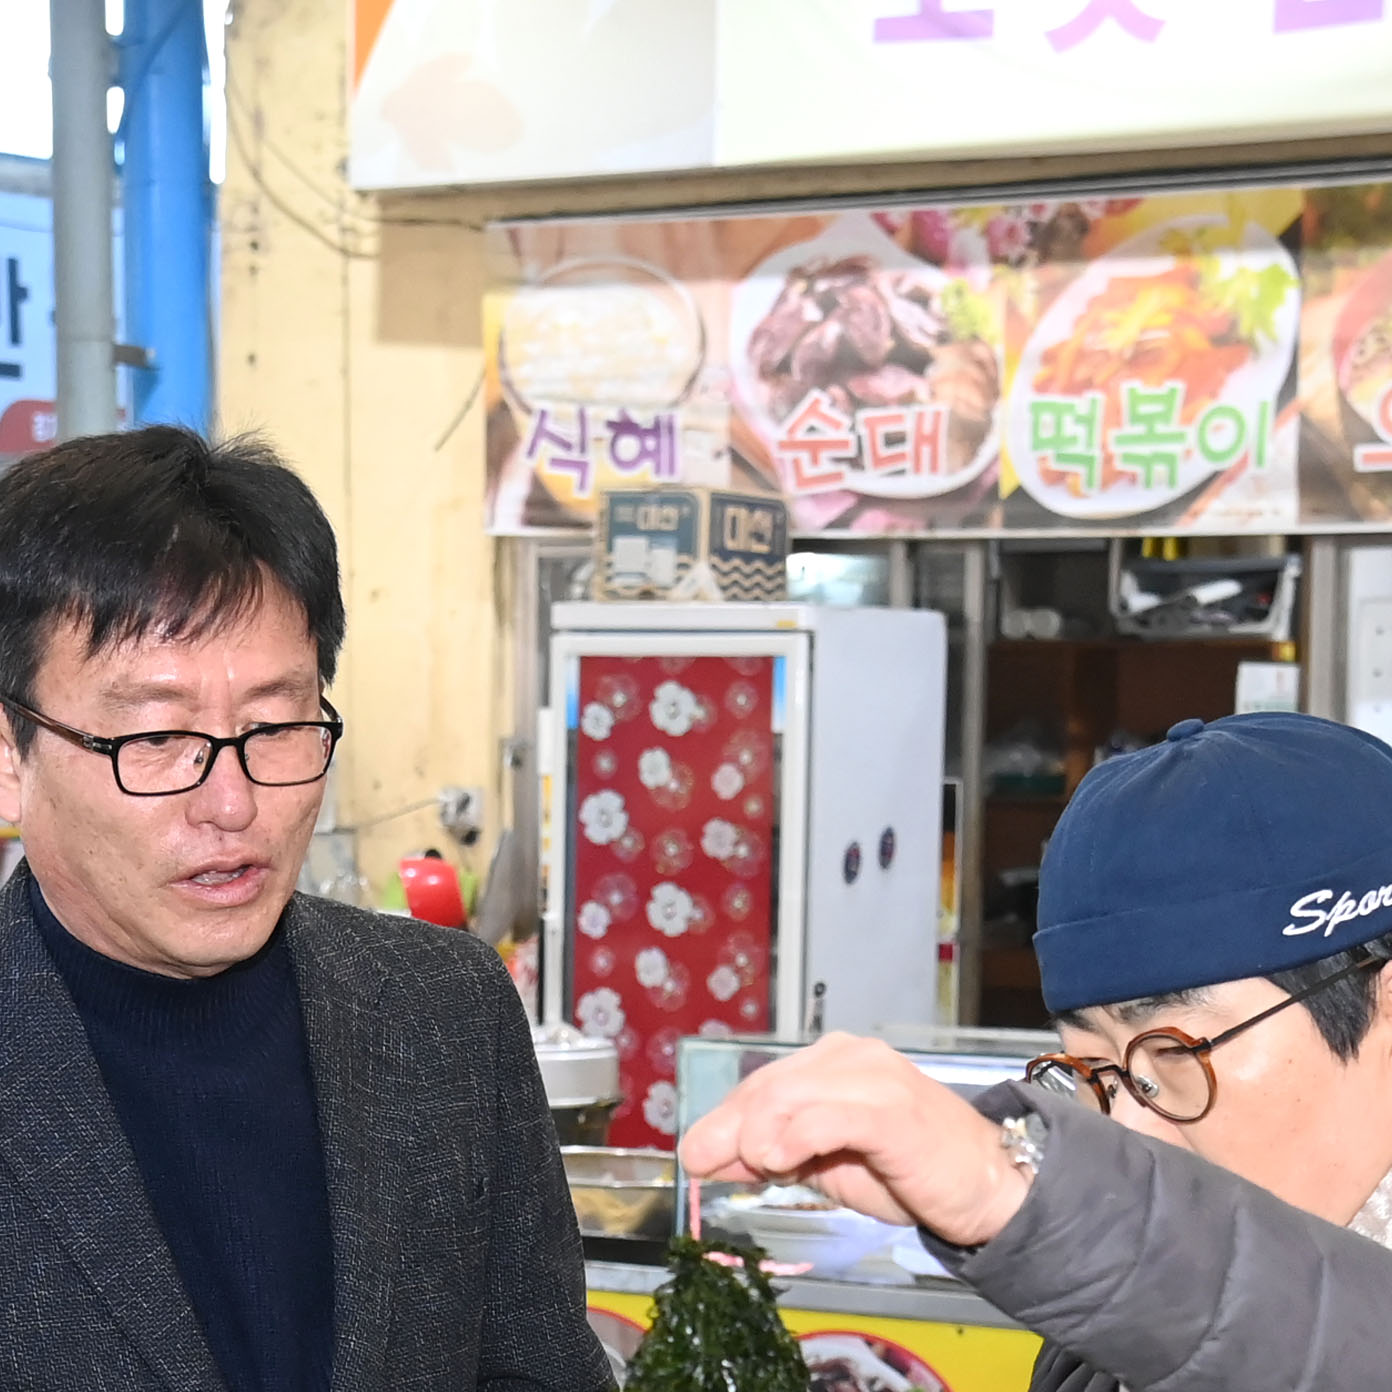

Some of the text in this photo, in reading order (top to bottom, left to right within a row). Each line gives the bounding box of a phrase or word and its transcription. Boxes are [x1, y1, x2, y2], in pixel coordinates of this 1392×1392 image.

[526, 405, 679, 493] 식혜
[778, 397, 945, 493] 순대
[1028, 384, 1270, 492] 떡볶이
